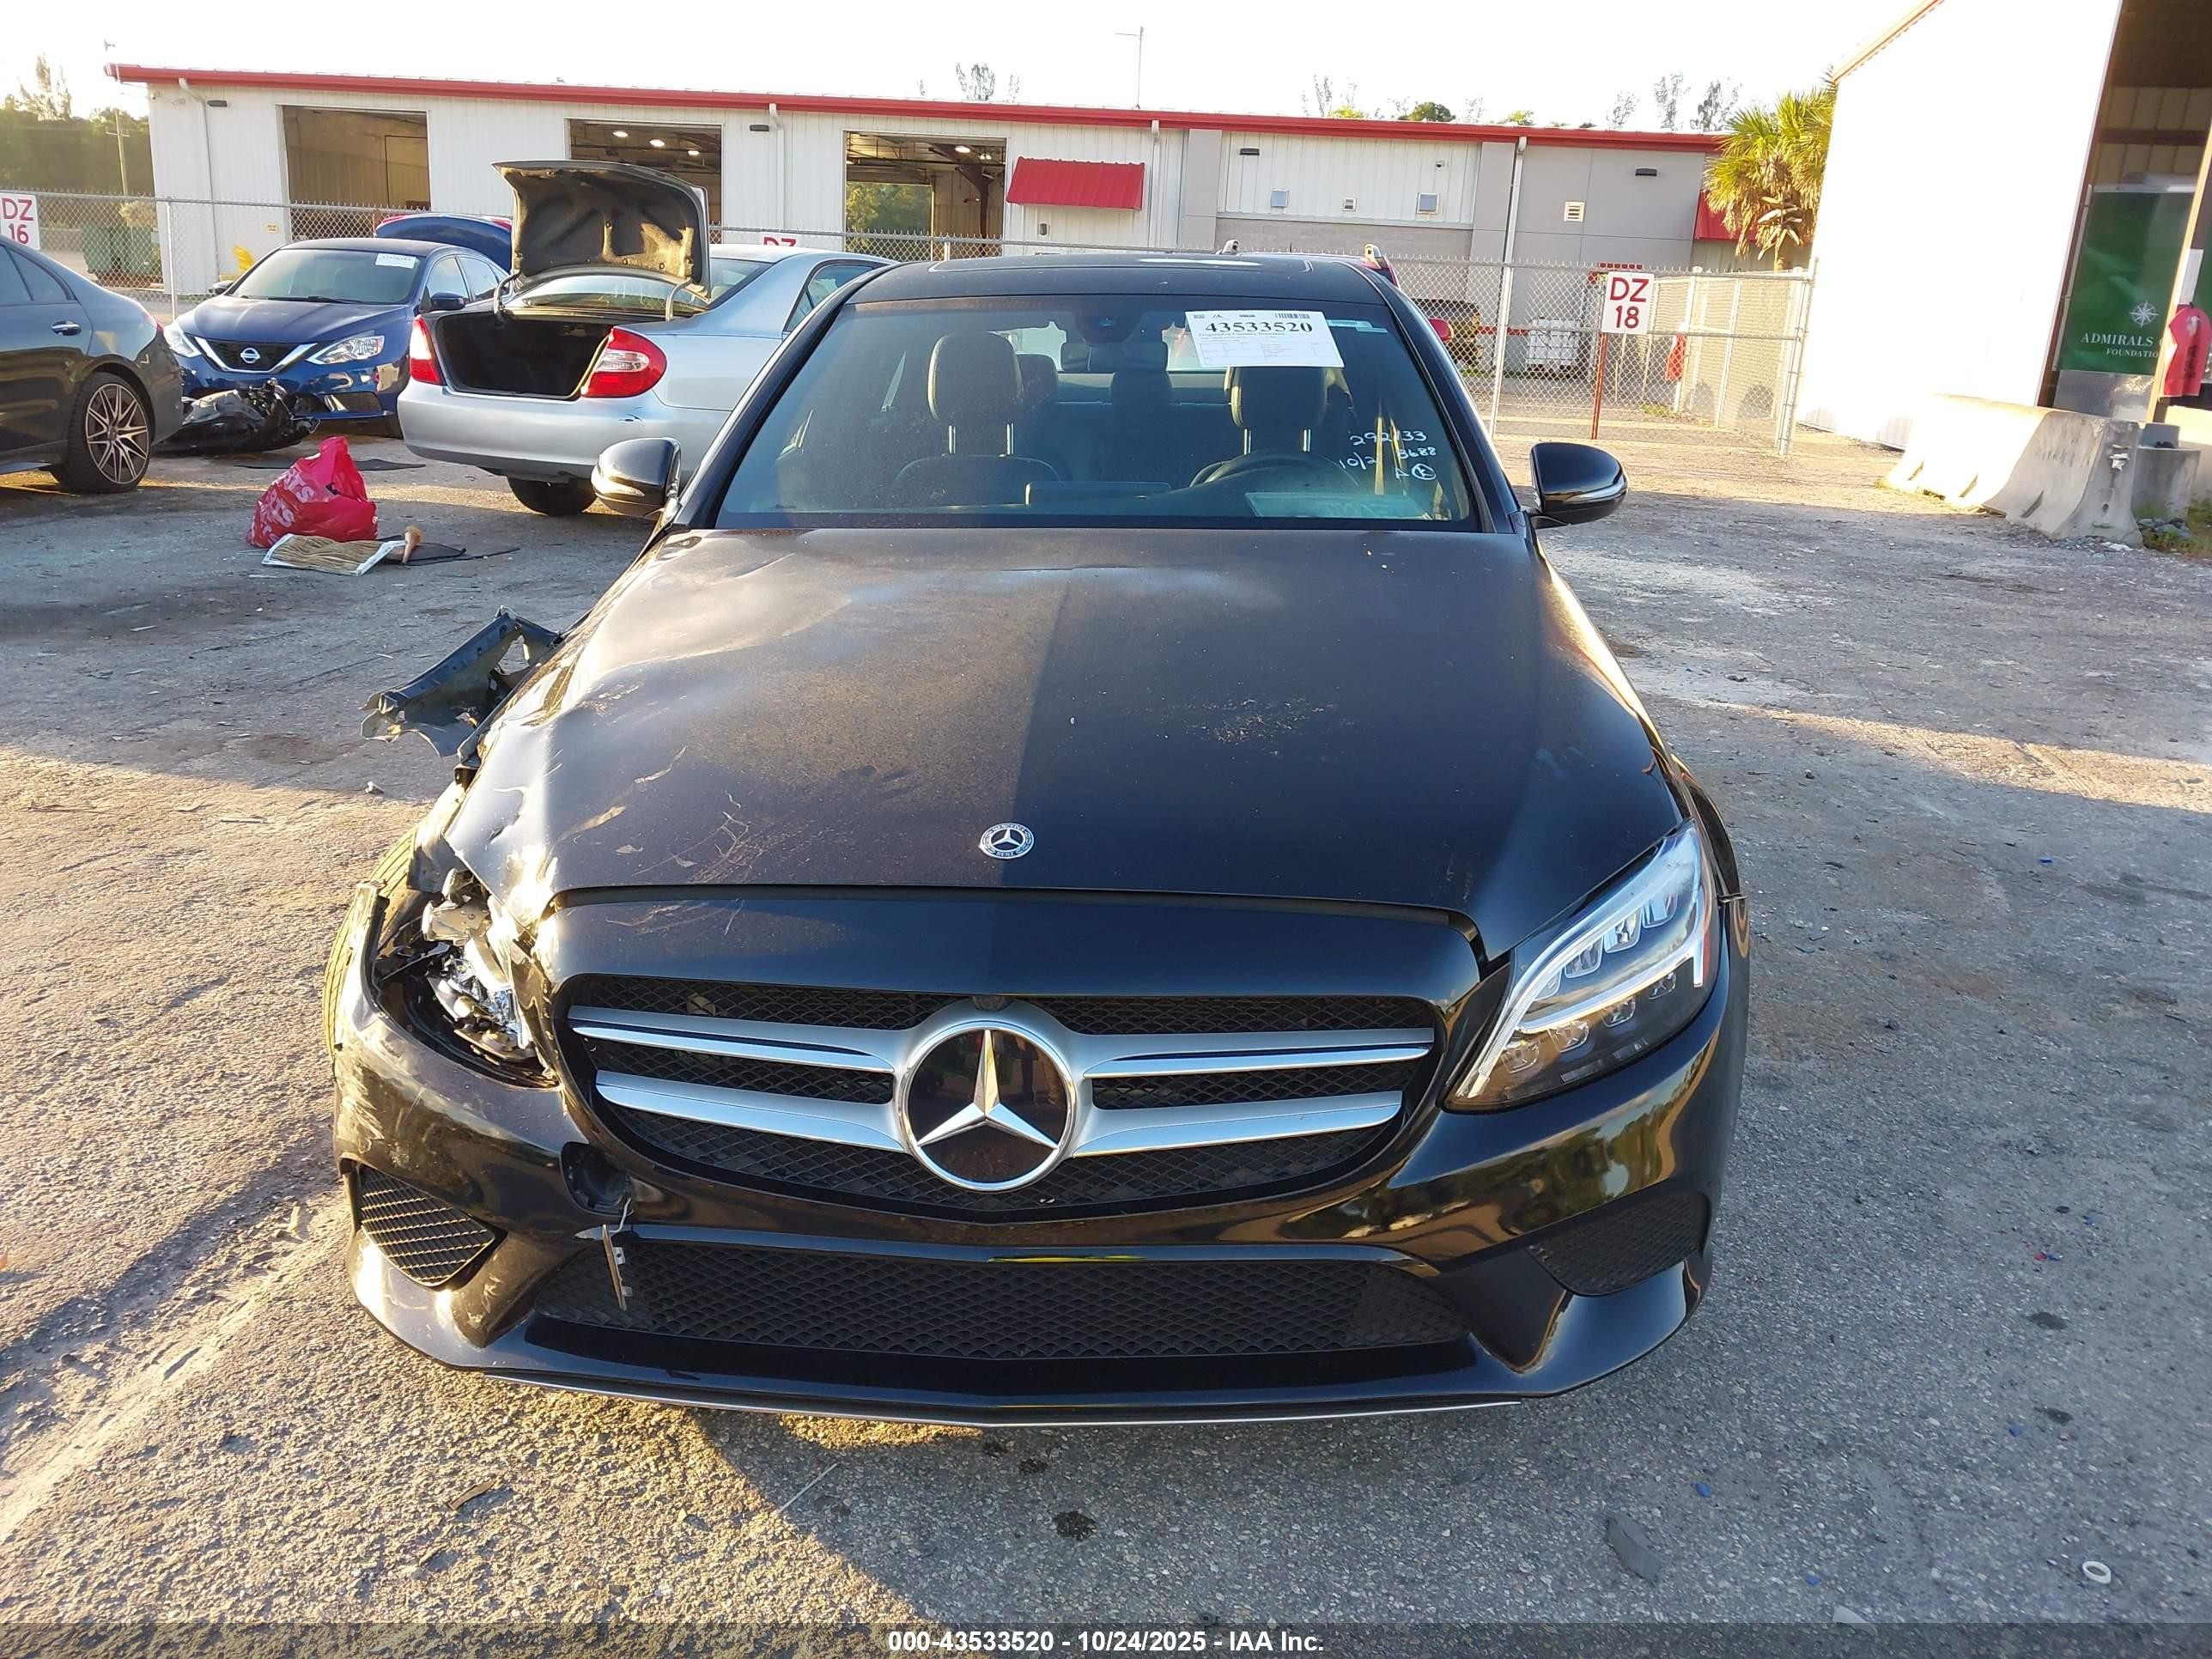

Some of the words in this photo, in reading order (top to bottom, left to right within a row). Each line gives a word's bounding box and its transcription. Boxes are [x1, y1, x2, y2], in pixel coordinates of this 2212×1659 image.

[2, 198, 34, 221] DZ
[9, 223, 29, 244] 16
[1609, 276, 1650, 302] DZ
[1205, 321, 1313, 333] 43533520
[1615, 305, 1639, 329] 18
[2081, 332, 2154, 347] ADMIRALS
